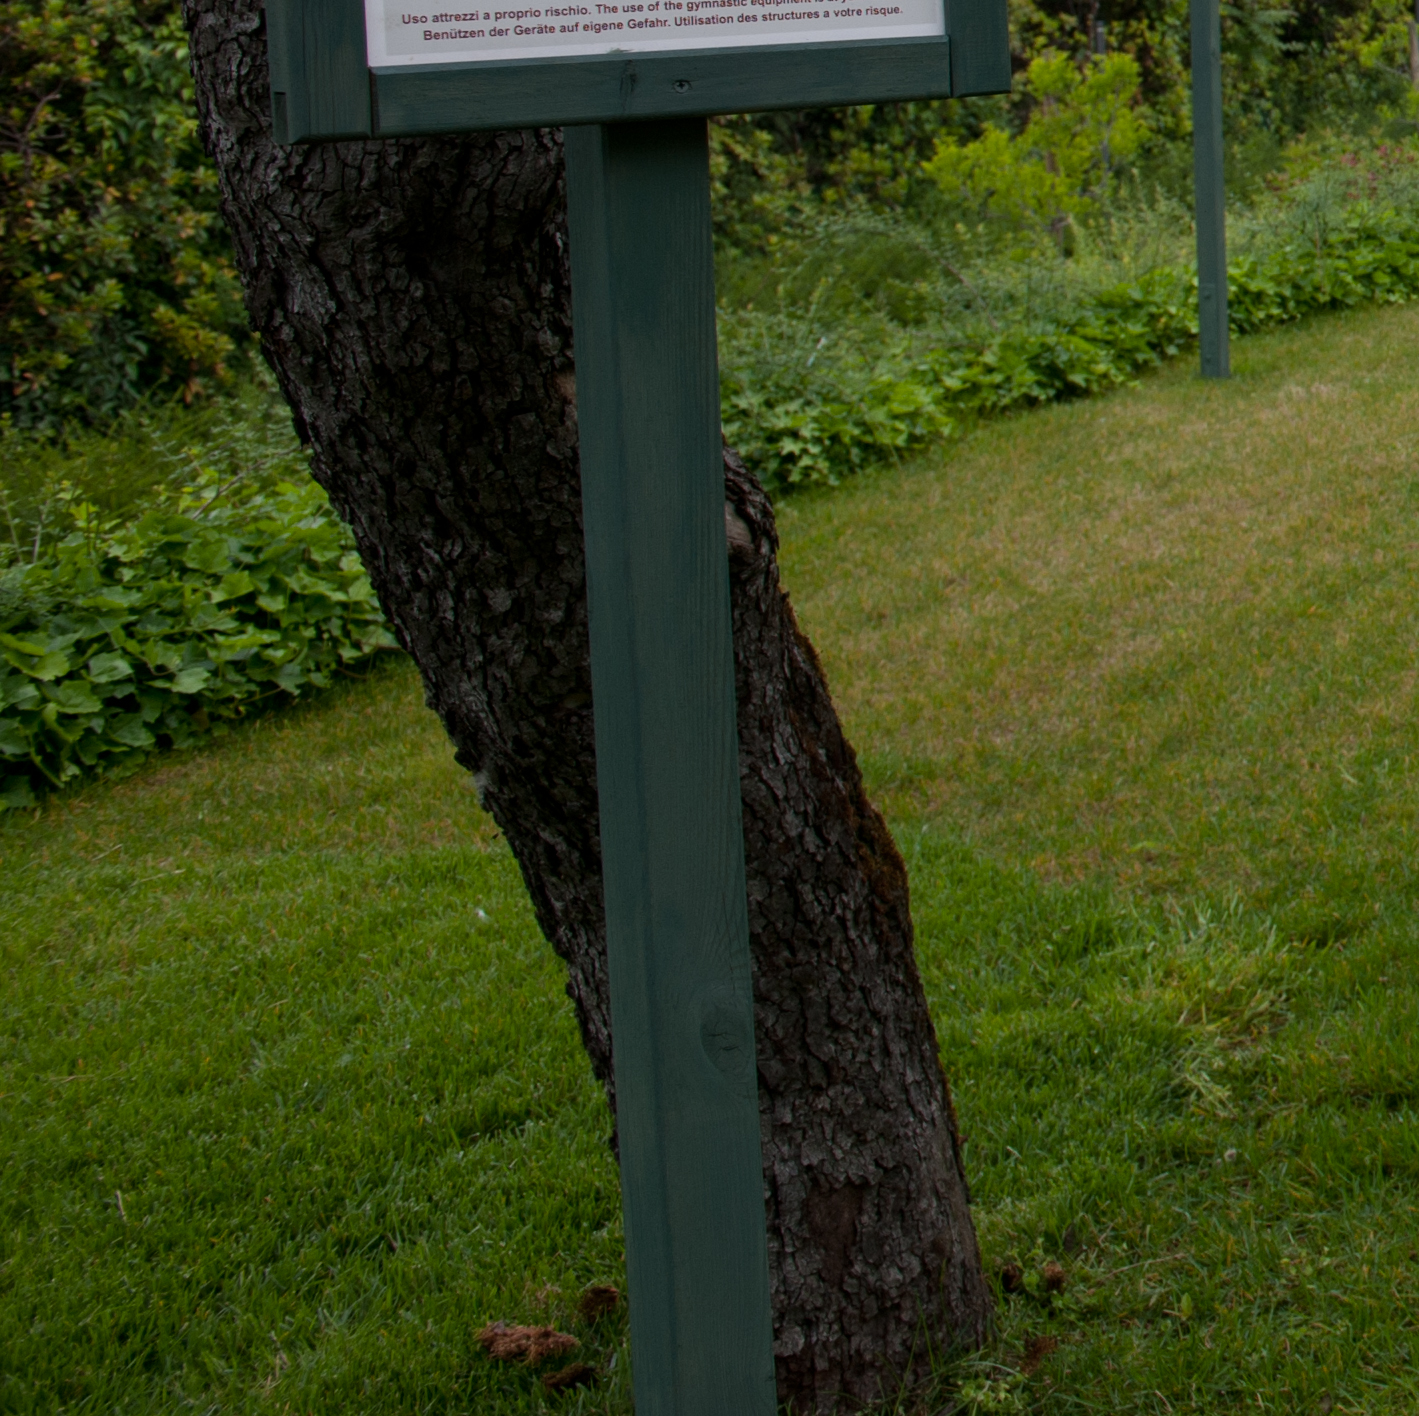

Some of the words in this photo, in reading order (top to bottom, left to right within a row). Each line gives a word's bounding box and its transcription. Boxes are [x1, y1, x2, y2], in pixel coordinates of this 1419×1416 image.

[402, 13, 428, 25] Uso
[431, 10, 479, 23] attrezzi
[483, 11, 491, 21] a
[495, 7, 541, 22] proprio
[545, 5, 591, 18] rischio.
[595, 3, 618, 15] The
[622, 2, 644, 13] use
[647, 0, 660, 11] of
[664, 0, 683, 11] the
[423, 26, 485, 41] Benützen
[489, 25, 510, 38] der
[514, 23, 555, 36] Geräte
[559, 21, 579, 33] auf
[583, 20, 624, 34] eigene
[627, 16, 671, 29] Gefahr.
[674, 13, 734, 27] Utilisation
[737, 11, 758, 23] des
[761, 8, 820, 22] structures
[823, 9, 830, 19] a
[833, 6, 863, 18] votre
[865, 4, 903, 18] risque.
